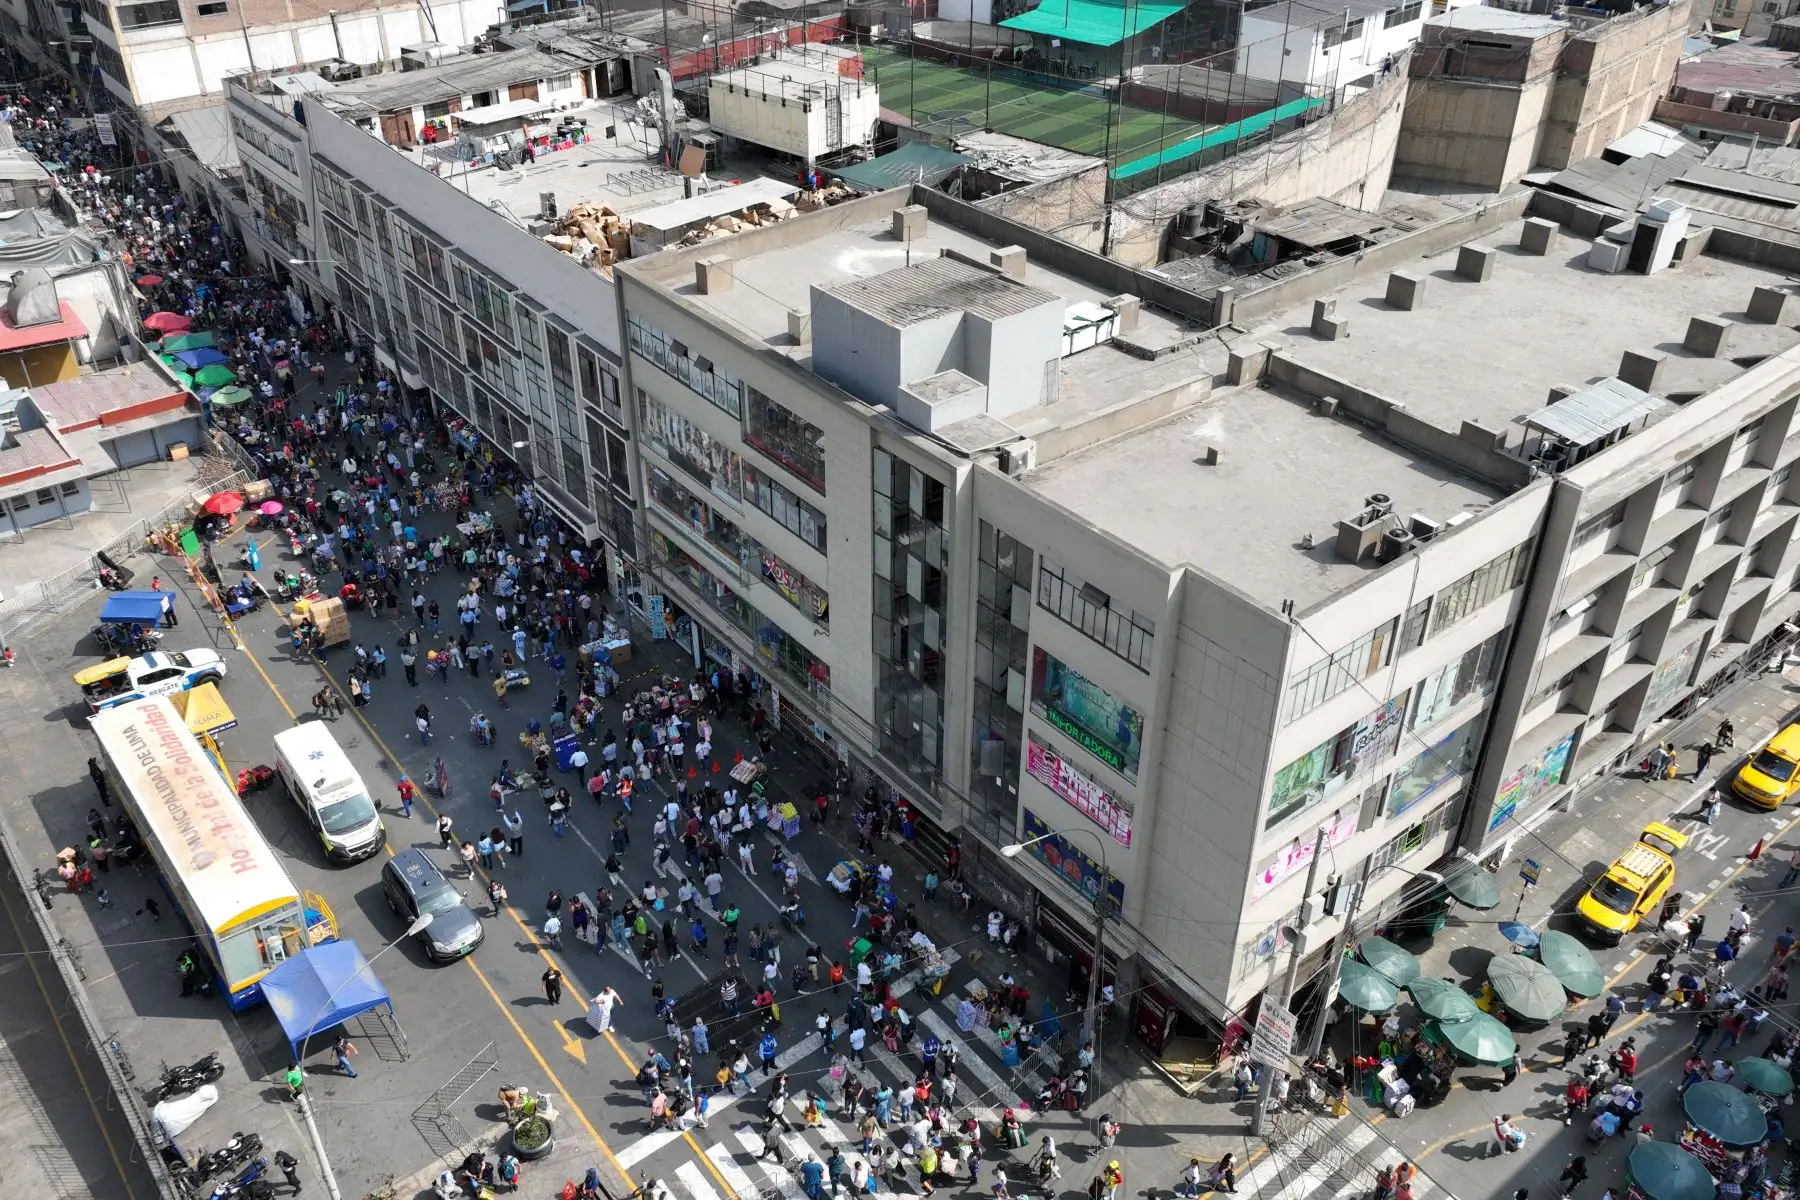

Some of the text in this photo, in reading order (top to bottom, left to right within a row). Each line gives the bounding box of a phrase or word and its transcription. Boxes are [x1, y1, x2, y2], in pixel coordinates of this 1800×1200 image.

[149, 682, 179, 697] RESCATE
[136, 704, 199, 776] Solidaridad
[1049, 711, 1119, 769] IMPORTADORA
[123, 724, 207, 853] MUNICIPALIDAD DE LIMA
